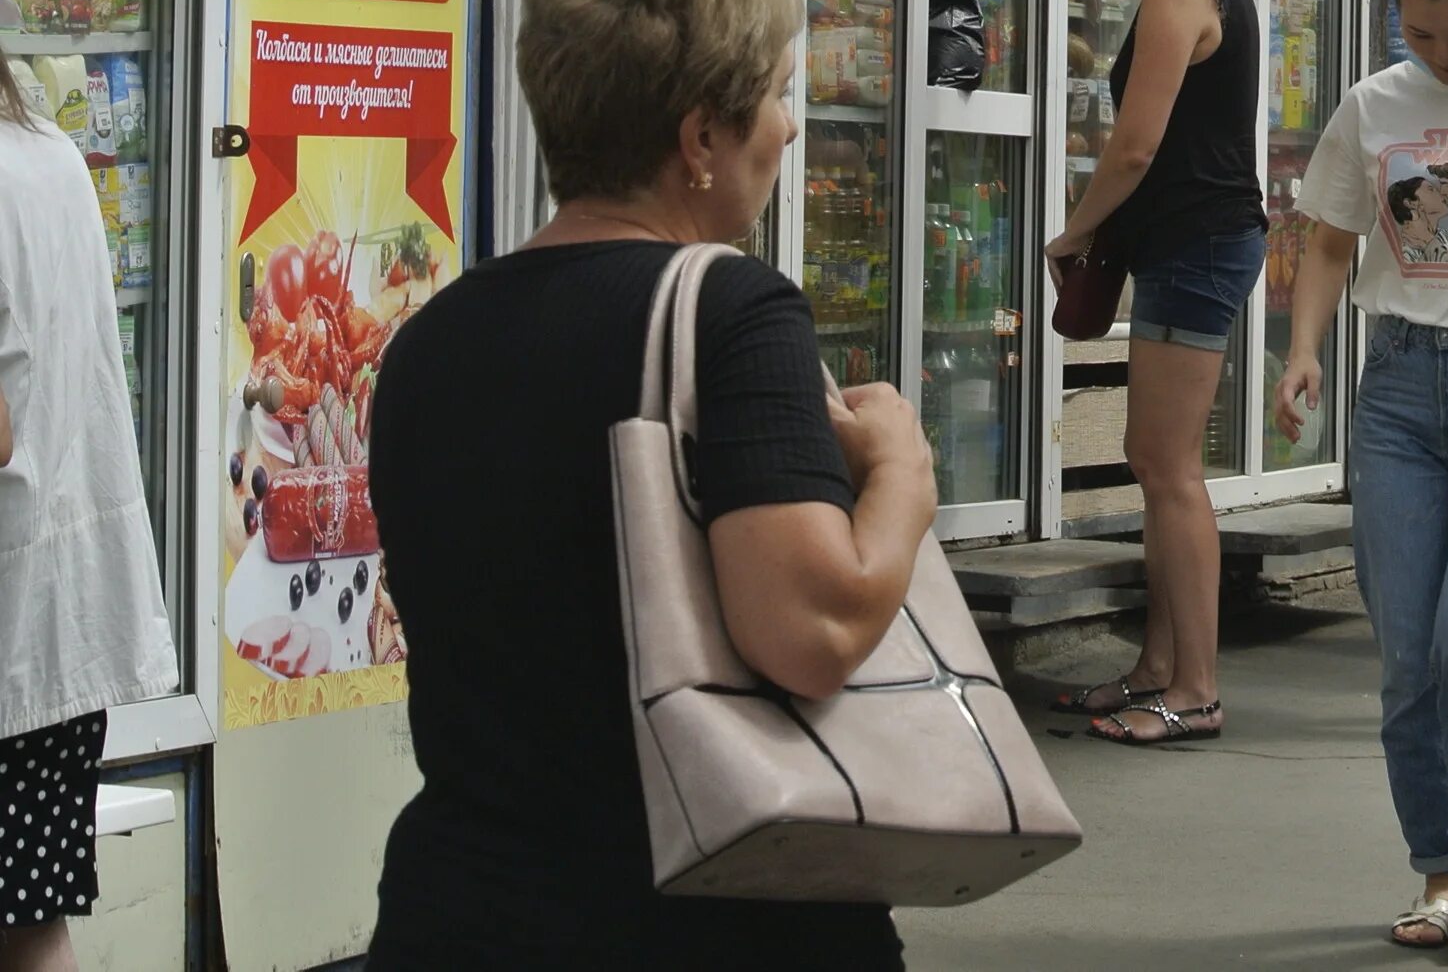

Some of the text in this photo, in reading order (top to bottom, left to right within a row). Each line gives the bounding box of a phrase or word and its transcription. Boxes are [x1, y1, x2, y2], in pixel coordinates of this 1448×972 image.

[256, 29, 448, 79] Колбасы и мясные деликатесы
[292, 79, 413, 120] от производителя!
